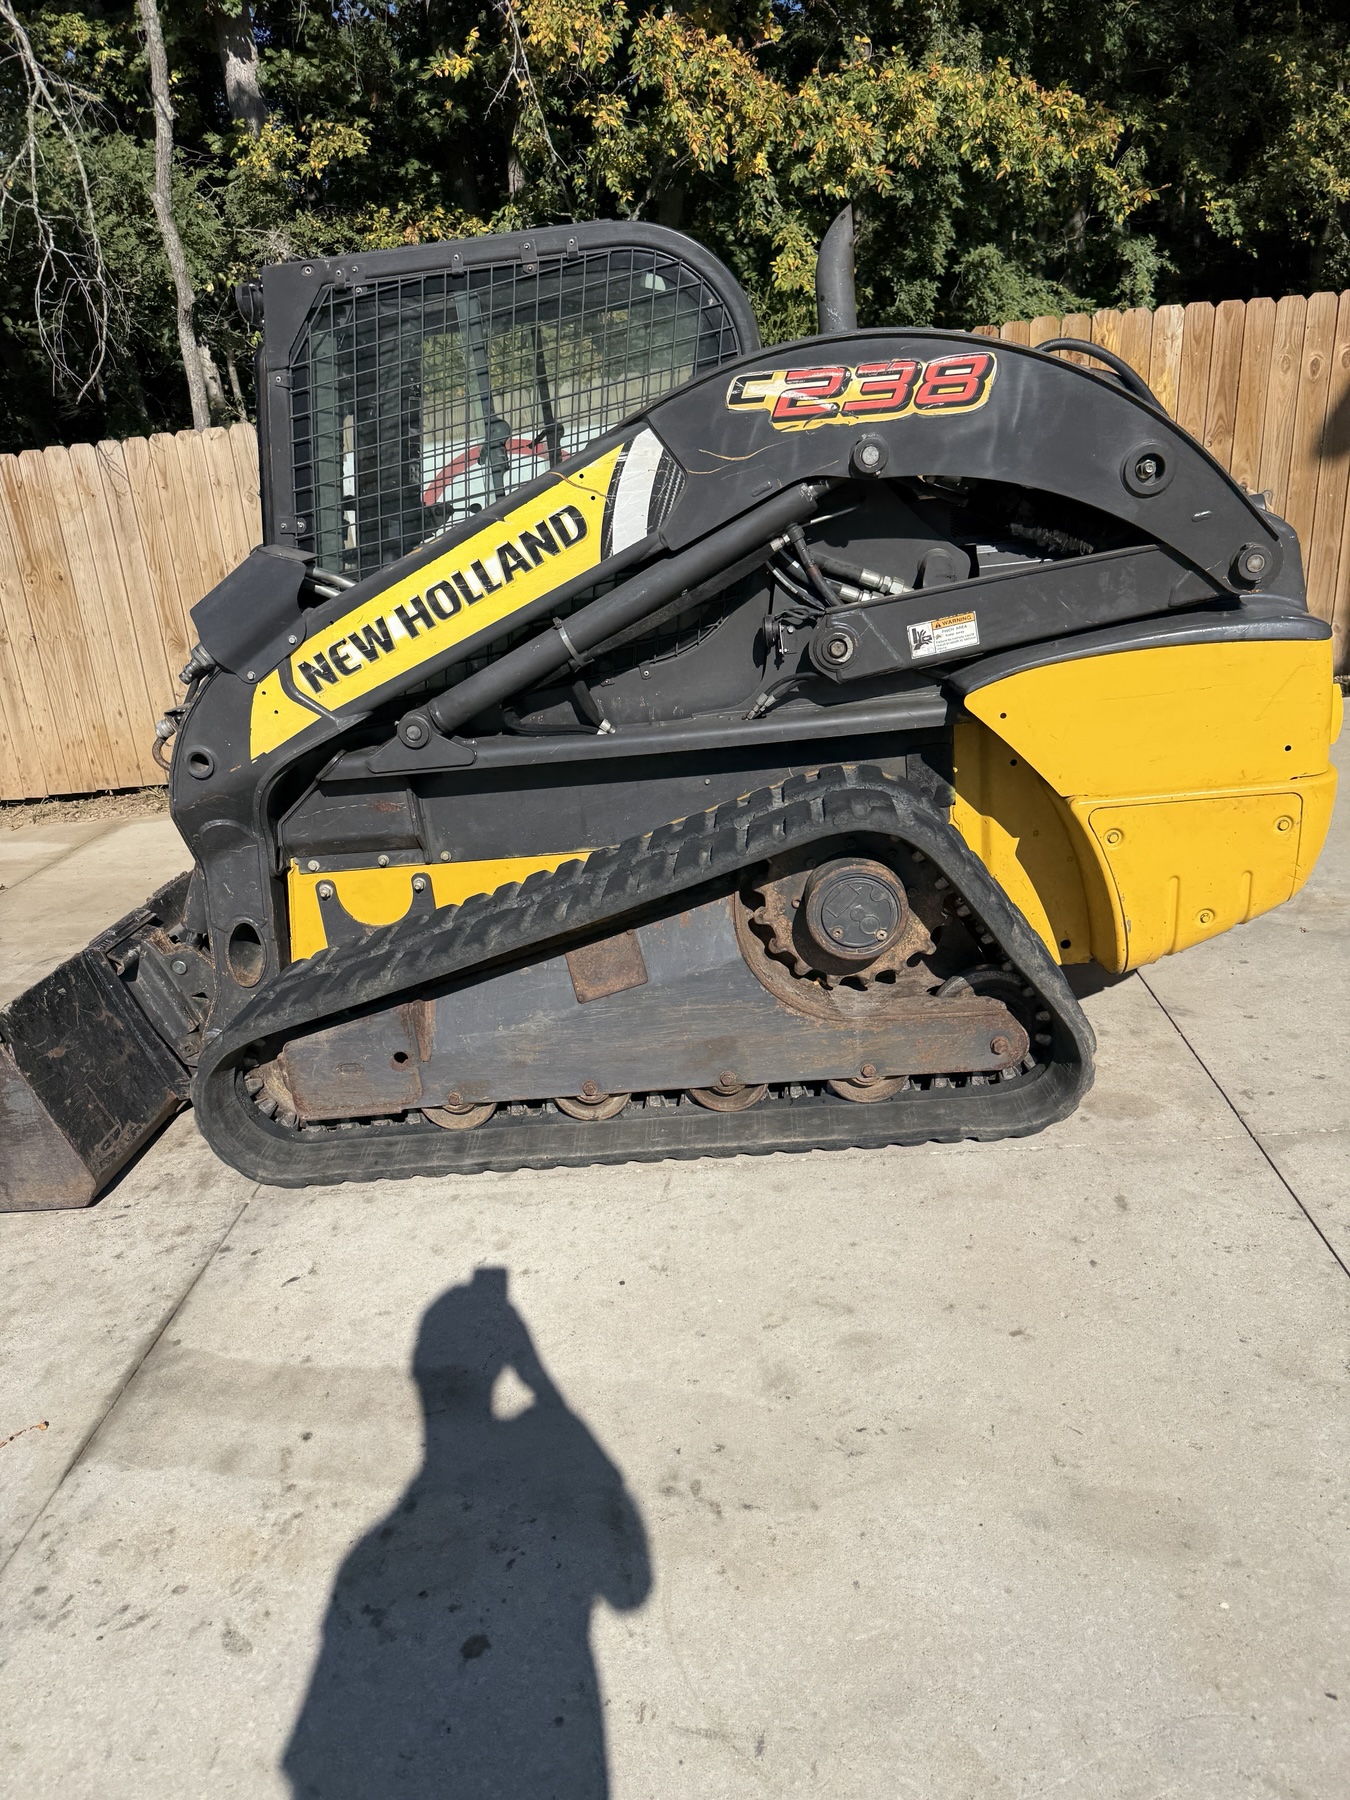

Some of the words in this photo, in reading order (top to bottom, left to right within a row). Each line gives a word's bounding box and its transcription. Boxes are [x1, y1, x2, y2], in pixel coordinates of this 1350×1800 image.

[296, 618, 397, 695] NEW
[394, 503, 590, 640] HOLLAND
[942, 615, 972, 626] WARNING
